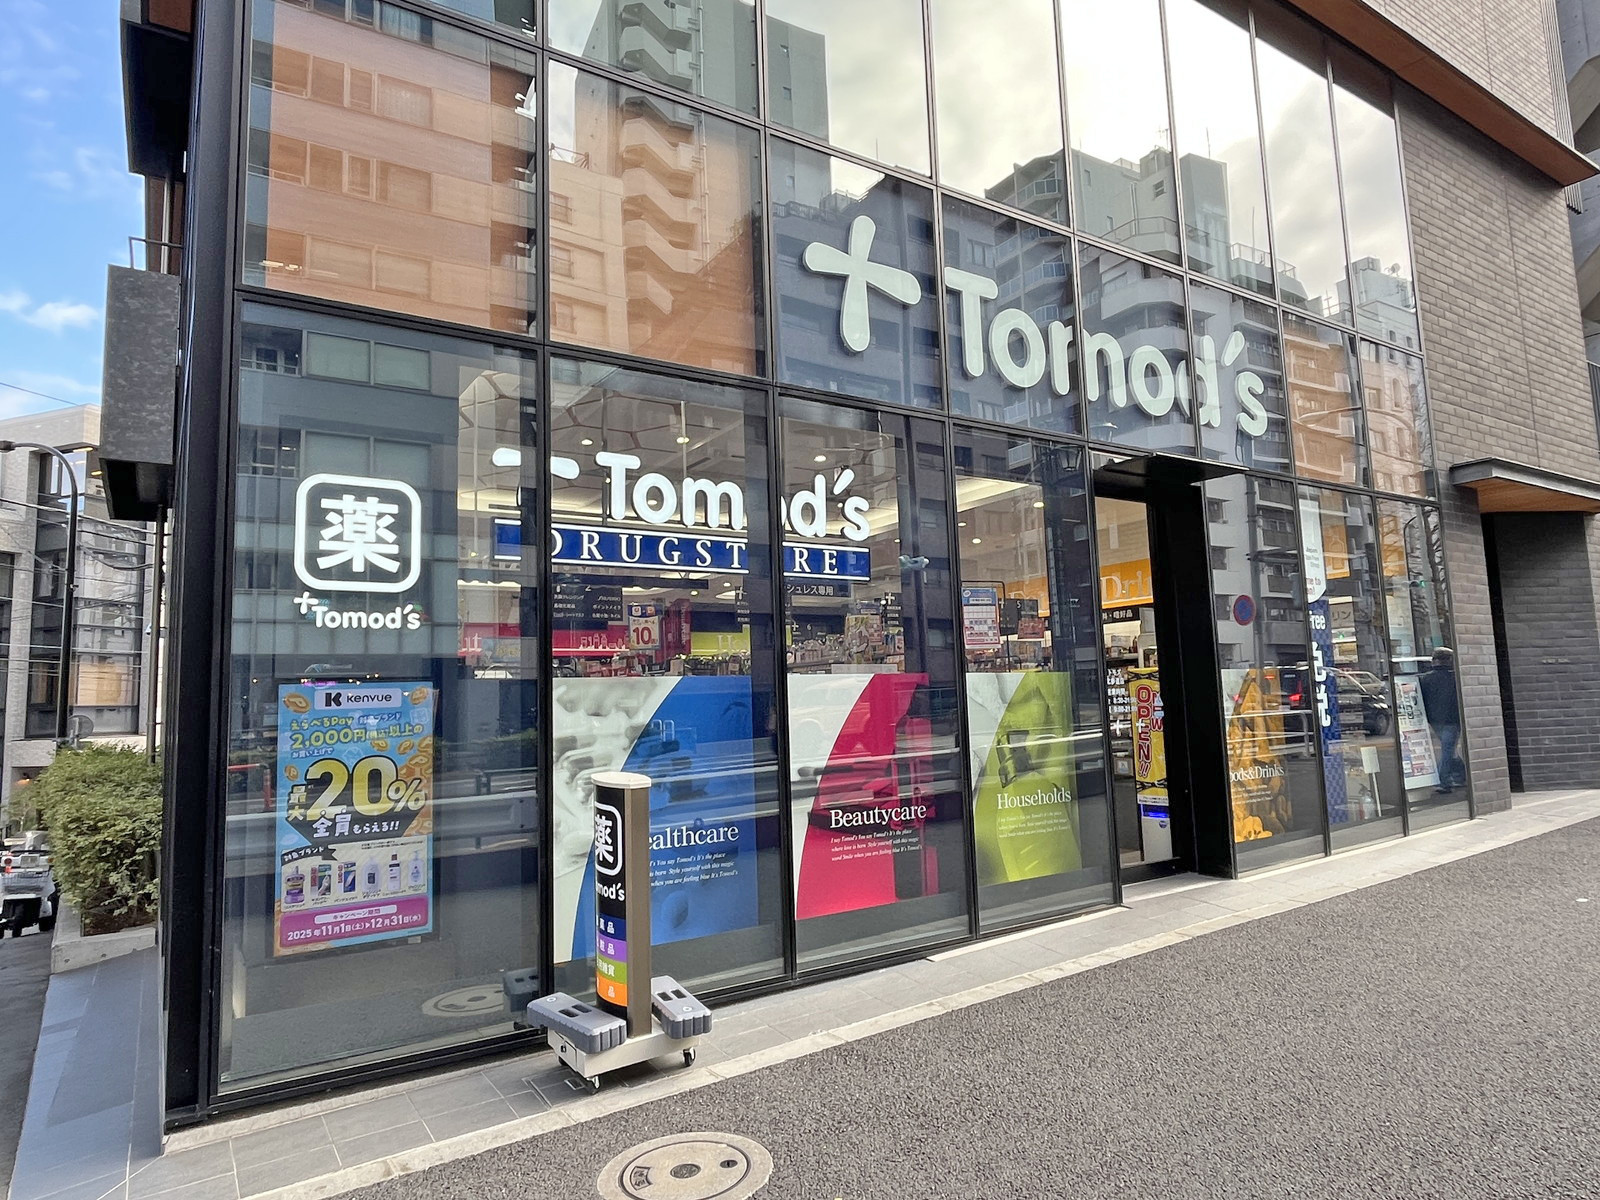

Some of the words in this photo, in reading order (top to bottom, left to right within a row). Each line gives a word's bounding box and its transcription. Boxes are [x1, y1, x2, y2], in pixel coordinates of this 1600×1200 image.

[944, 266, 1268, 437] Tomod's
[316, 494, 401, 574] 薬
[785, 583, 834, 596] シュレス専用
[1101, 570, 1152, 601] Dri
[313, 603, 421, 630] Tomod's
[633, 626, 652, 645] 10
[305, 755, 426, 820] 20%
[996, 787, 1072, 810] Households
[829, 804, 927, 828] Beautycare
